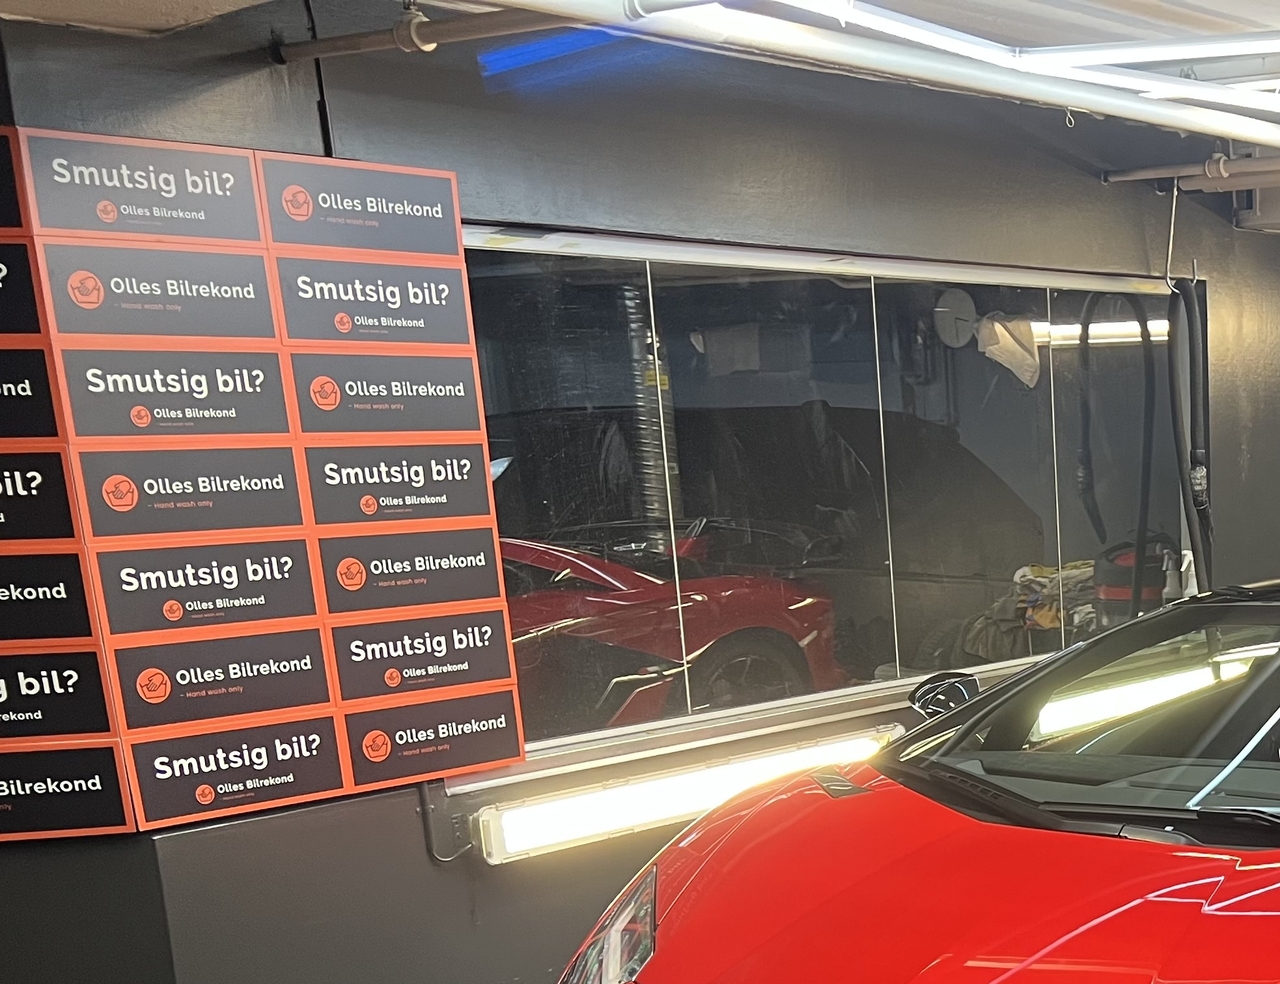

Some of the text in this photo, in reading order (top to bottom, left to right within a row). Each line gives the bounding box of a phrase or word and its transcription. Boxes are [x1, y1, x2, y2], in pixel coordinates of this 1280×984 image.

[52, 158, 234, 198] Smutsig bil?
[120, 204, 205, 220] Olles Bilrekond
[318, 192, 443, 218] Olles Bilrekond
[110, 277, 255, 299] Olles Bilrekond
[297, 275, 450, 309] Smutsig bil?
[354, 316, 424, 328] Olles Bilrekond
[0, 379, 32, 396] nd
[86, 368, 264, 399] Smutsig bil?
[345, 380, 465, 396] Olles Bilrekond
[154, 407, 236, 418] Olles Bilrekond
[0, 470, 42, 496] il?
[324, 458, 471, 488] Smutsig bil?
[143, 474, 284, 495] Olles Bilrekond
[379, 494, 448, 506] Olles Bilrekond
[120, 556, 293, 592] Smutsig bil?
[370, 552, 486, 575] Olles Bilrekond
[185, 594, 266, 612] Olles Bilrekond
[350, 625, 492, 662] Smutsig bil?
[176, 654, 312, 685] Olles Bilrekond
[402, 661, 469, 678] Olles Bilrekond
[18, 670, 78, 695] bil?
[186, 690, 206, 698] Hand
[208, 688, 227, 696] wash
[228, 686, 244, 694] only
[0, 710, 42, 721] ekond
[395, 714, 506, 744] Olles Bilrekond
[154, 734, 321, 780] Smutsig bil?
[0, 774, 102, 796] Bilrekond
[216, 773, 294, 794] Olles Bilrekond
